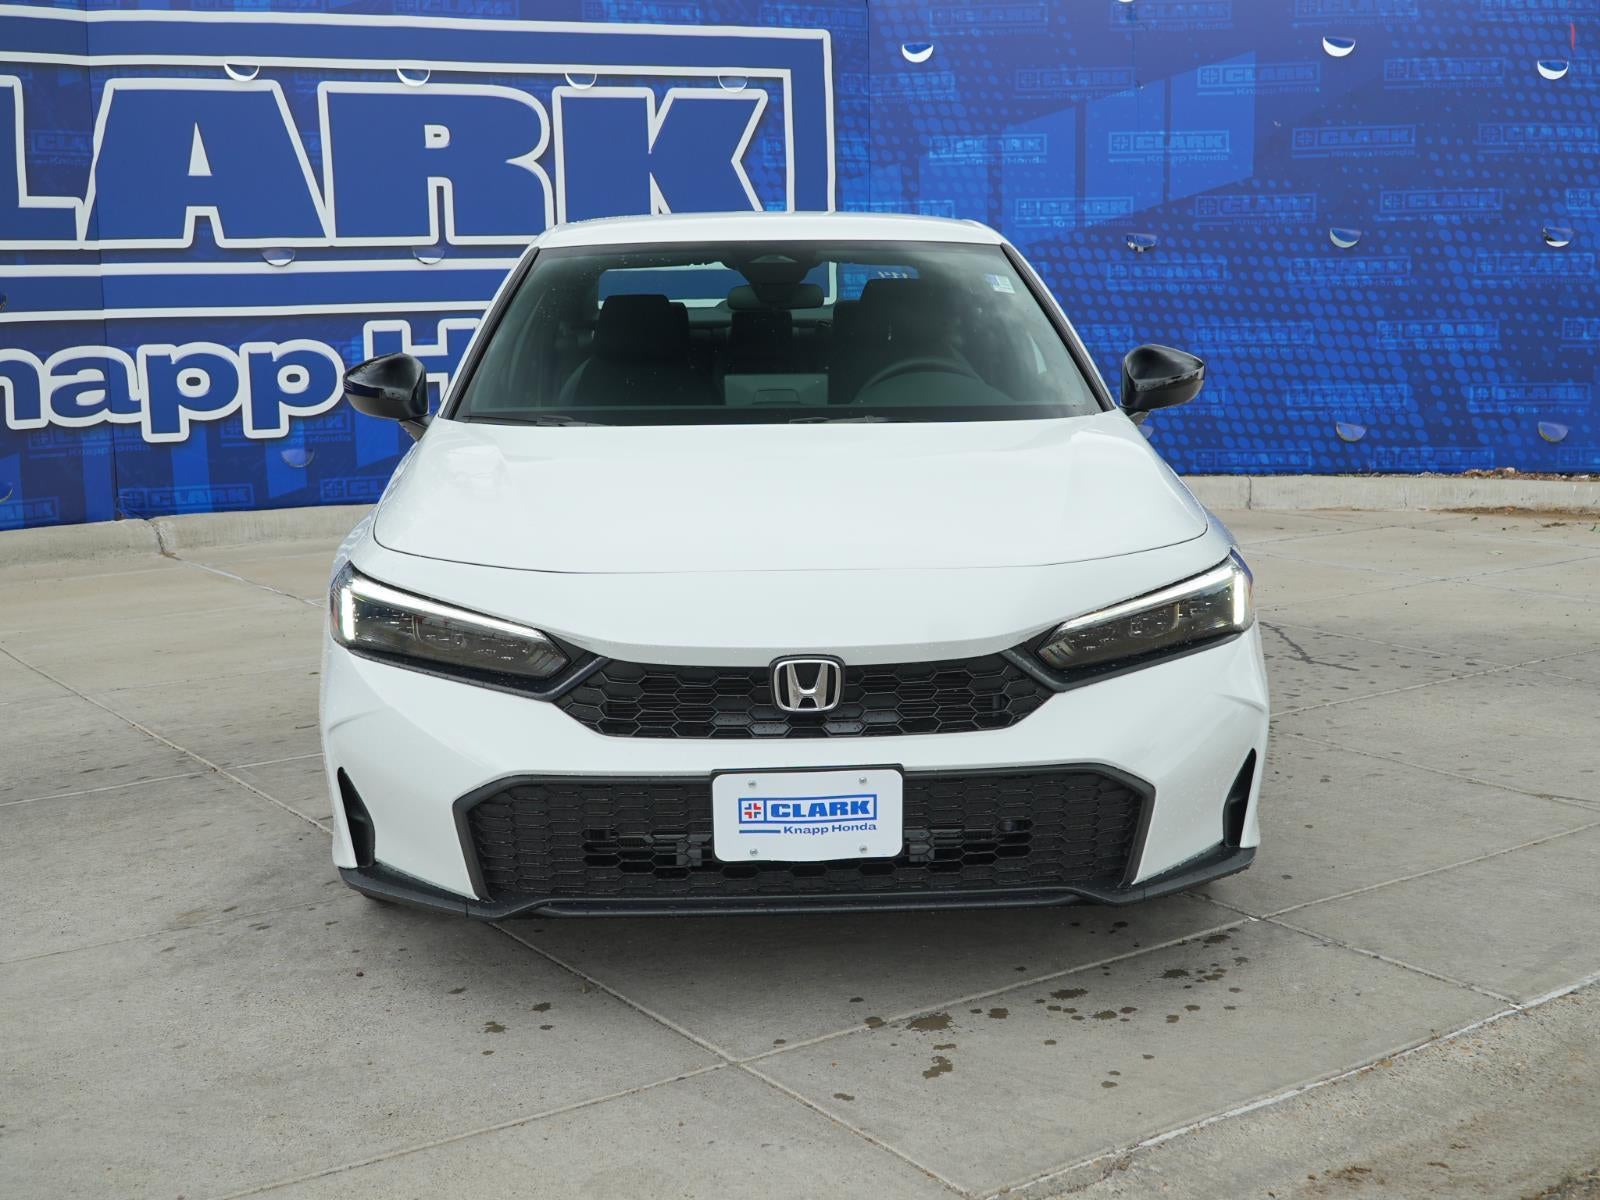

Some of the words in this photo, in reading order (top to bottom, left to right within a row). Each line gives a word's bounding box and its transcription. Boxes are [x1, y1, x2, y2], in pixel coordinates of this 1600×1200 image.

[1136, 134, 1225, 150] CLARK
[770, 800, 870, 818] CLARK
[783, 825, 829, 836] Knapp
[831, 822, 877, 832] Honda
